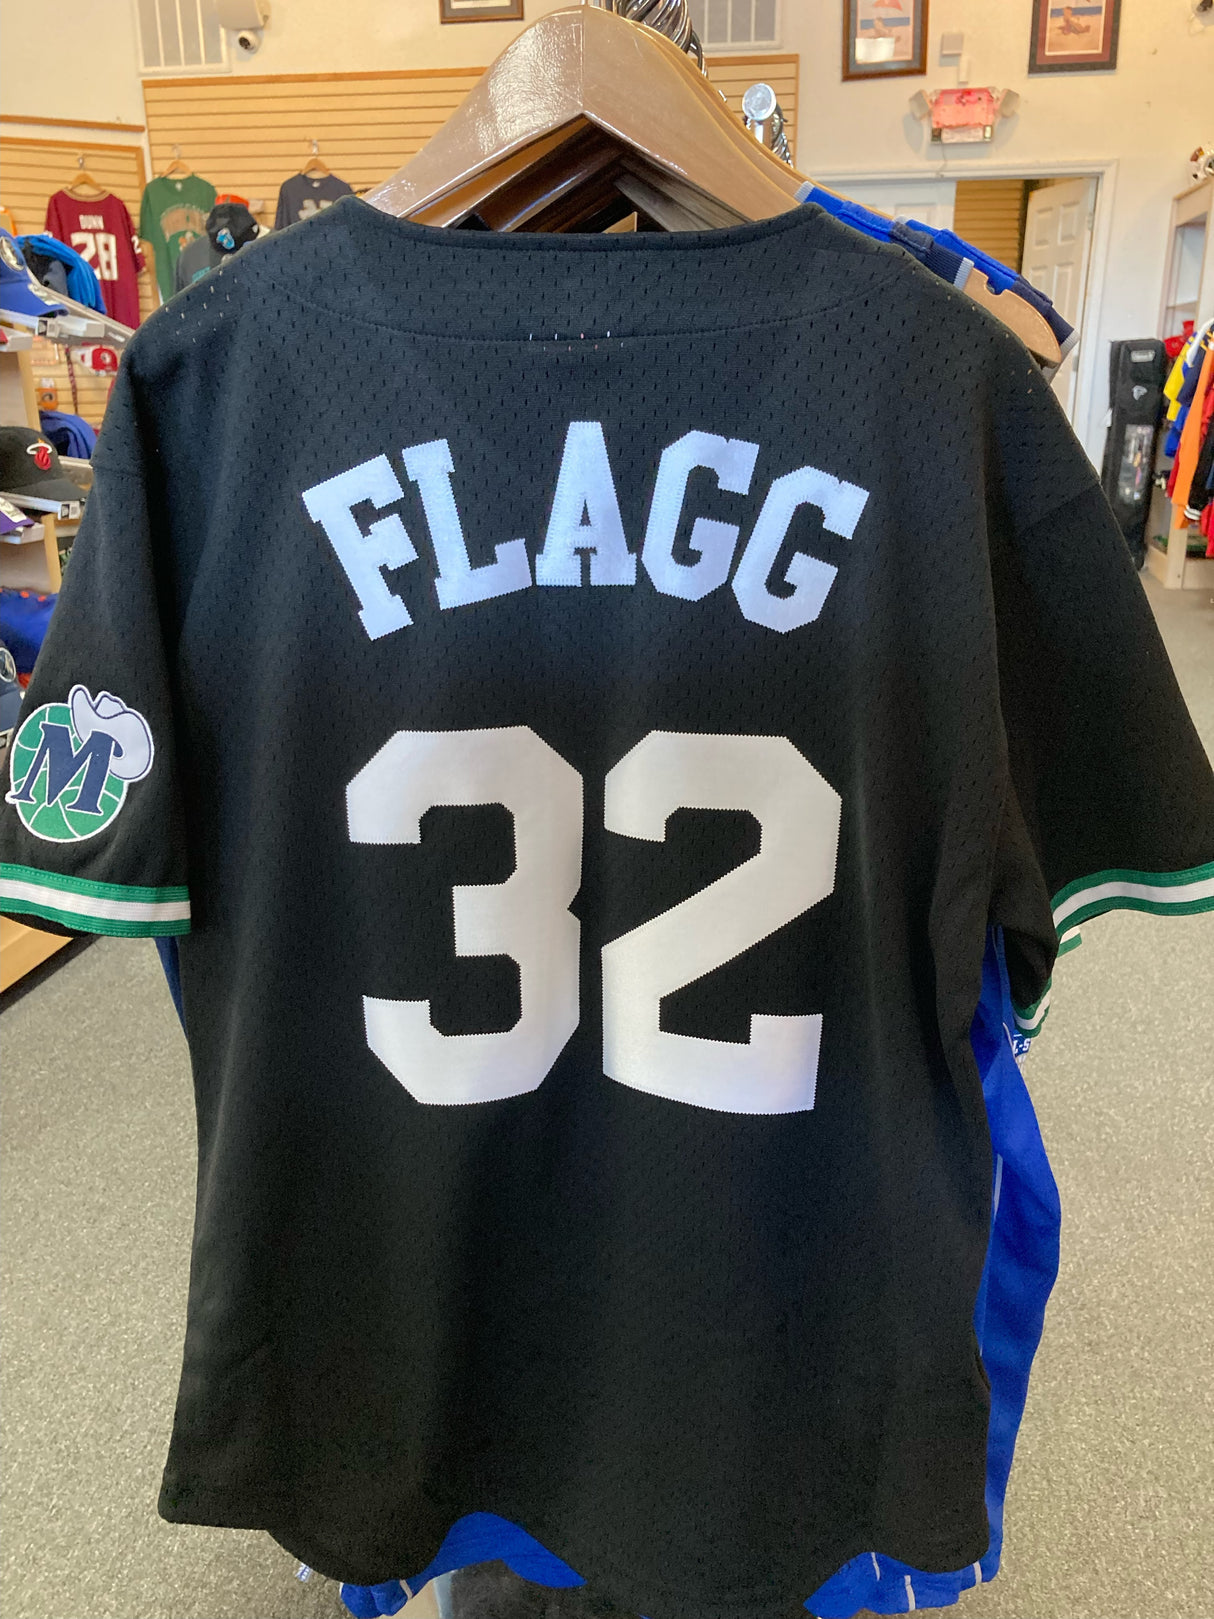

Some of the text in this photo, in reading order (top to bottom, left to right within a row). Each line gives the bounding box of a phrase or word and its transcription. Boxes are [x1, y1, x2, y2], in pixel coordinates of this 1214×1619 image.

[71, 231, 118, 281] 28
[302, 421, 869, 641] FLAGG
[345, 725, 842, 1115] 32
